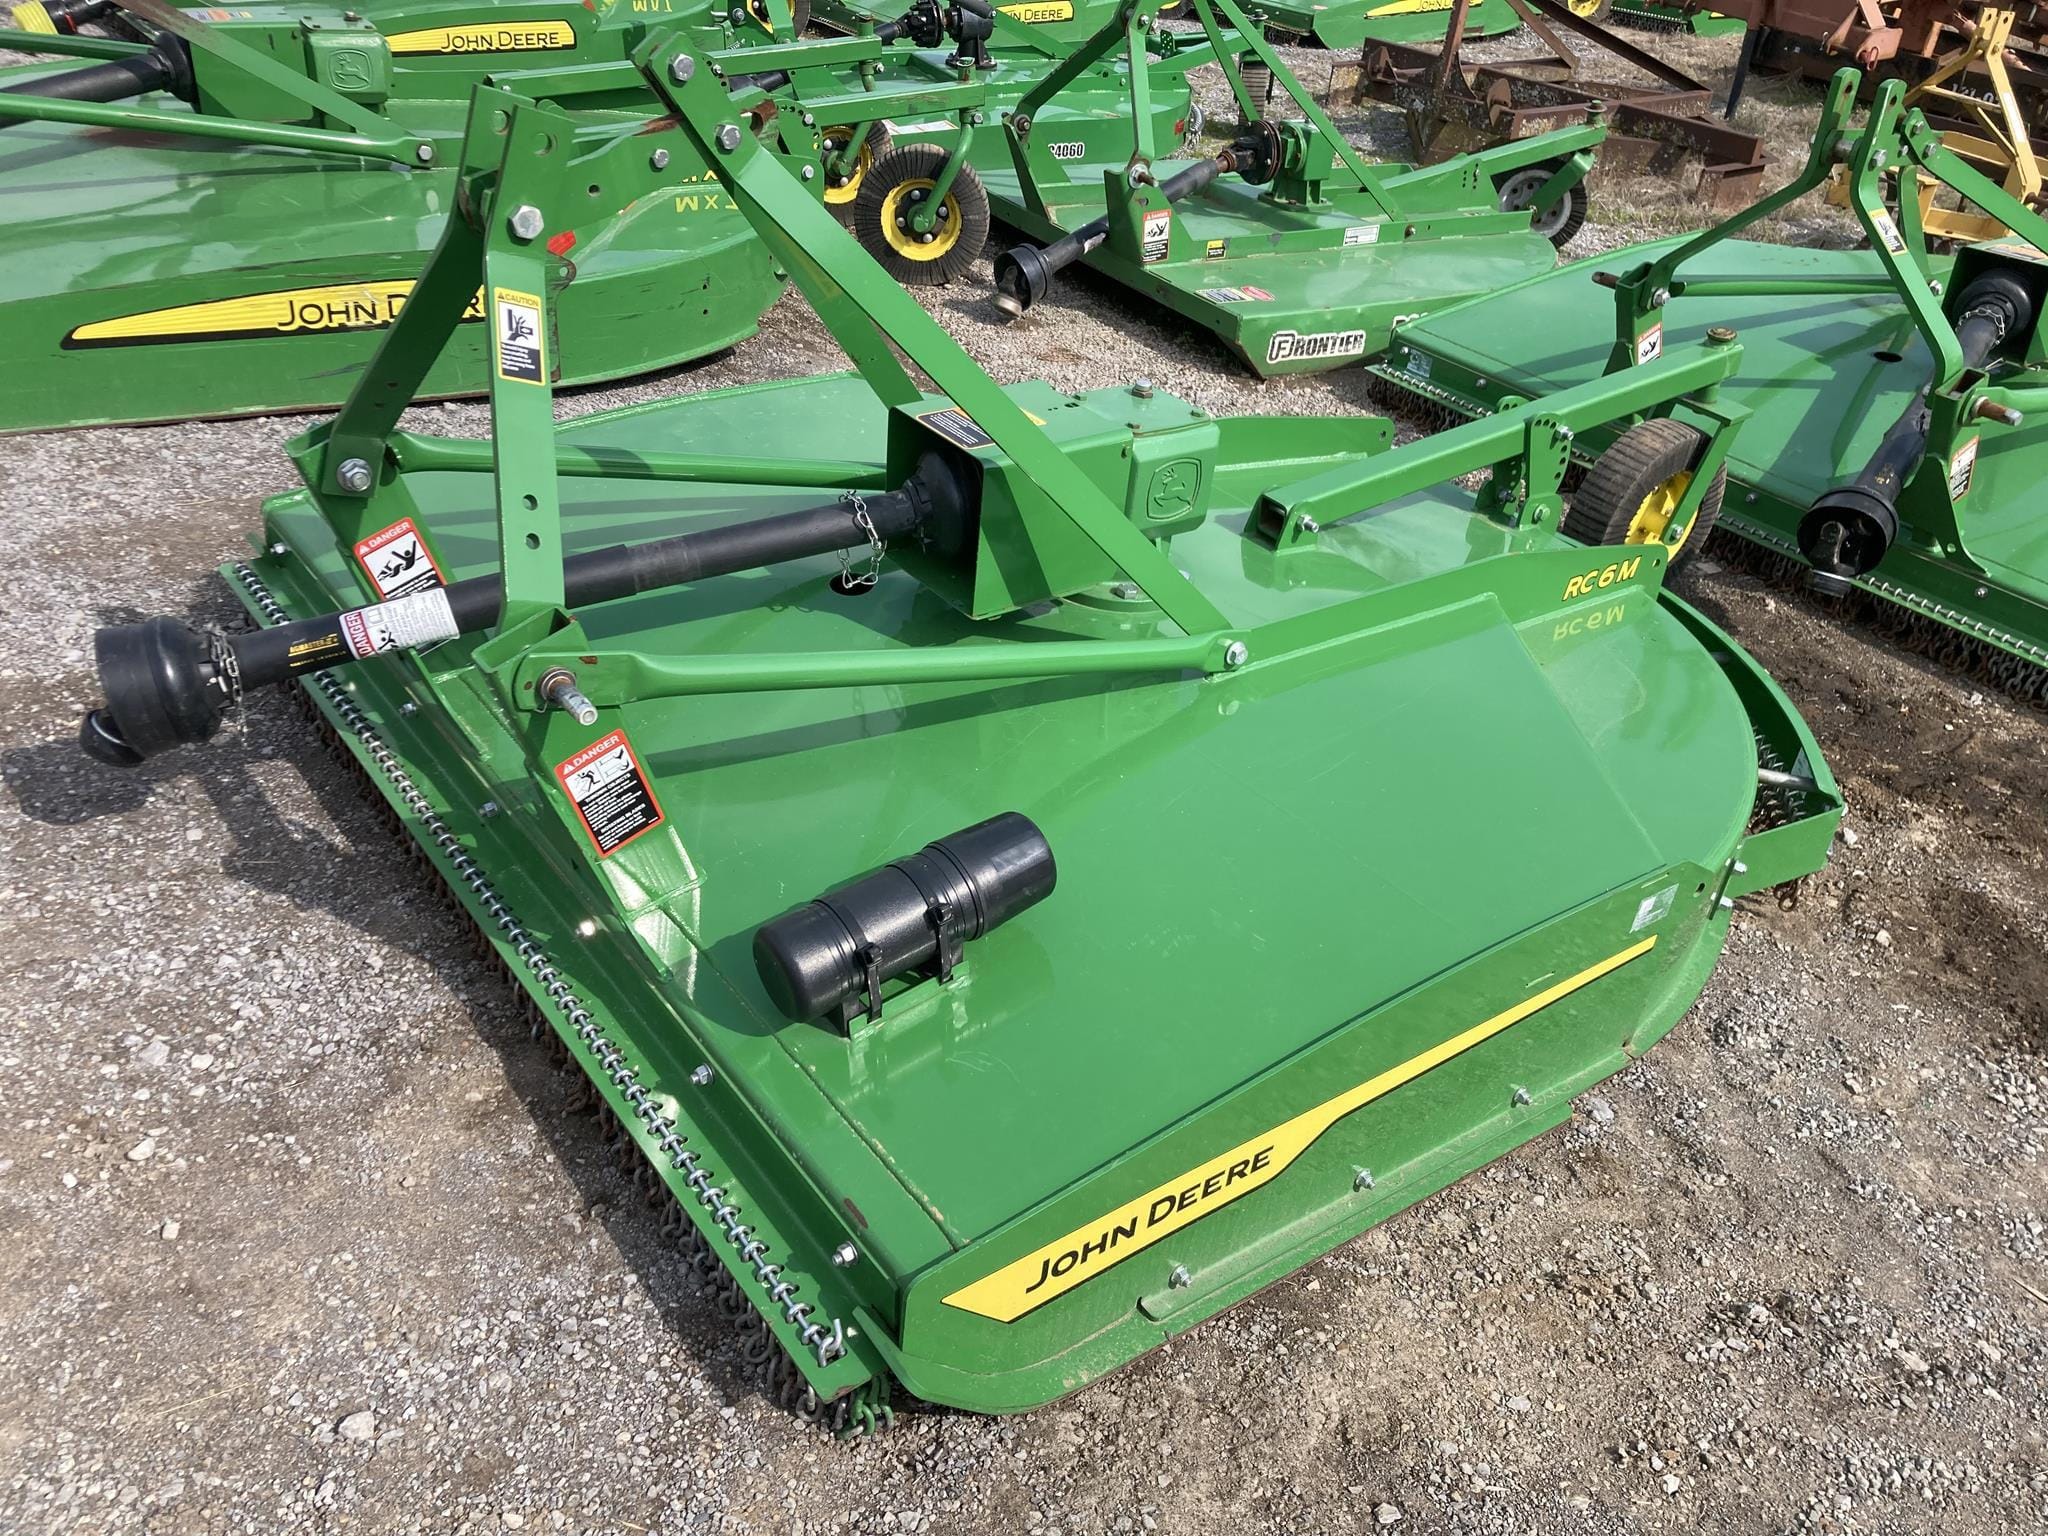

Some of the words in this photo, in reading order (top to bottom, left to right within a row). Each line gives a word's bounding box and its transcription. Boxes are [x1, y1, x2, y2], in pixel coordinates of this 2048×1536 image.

[1024, 9, 1064, 21] DEERE
[441, 33, 493, 49] JOHN
[499, 31, 560, 47] DEERE
[278, 299, 377, 327] JOHN
[505, 293, 539, 307] CAUTION
[1268, 332, 1364, 362] FRONTIER
[368, 521, 411, 548] DANGER
[1562, 555, 1642, 601] RC6M
[346, 612, 376, 657] DANGER
[573, 735, 620, 767] DANGER
[1025, 1216, 1138, 1294] JOHN
[1147, 1145, 1274, 1229] DEERE
